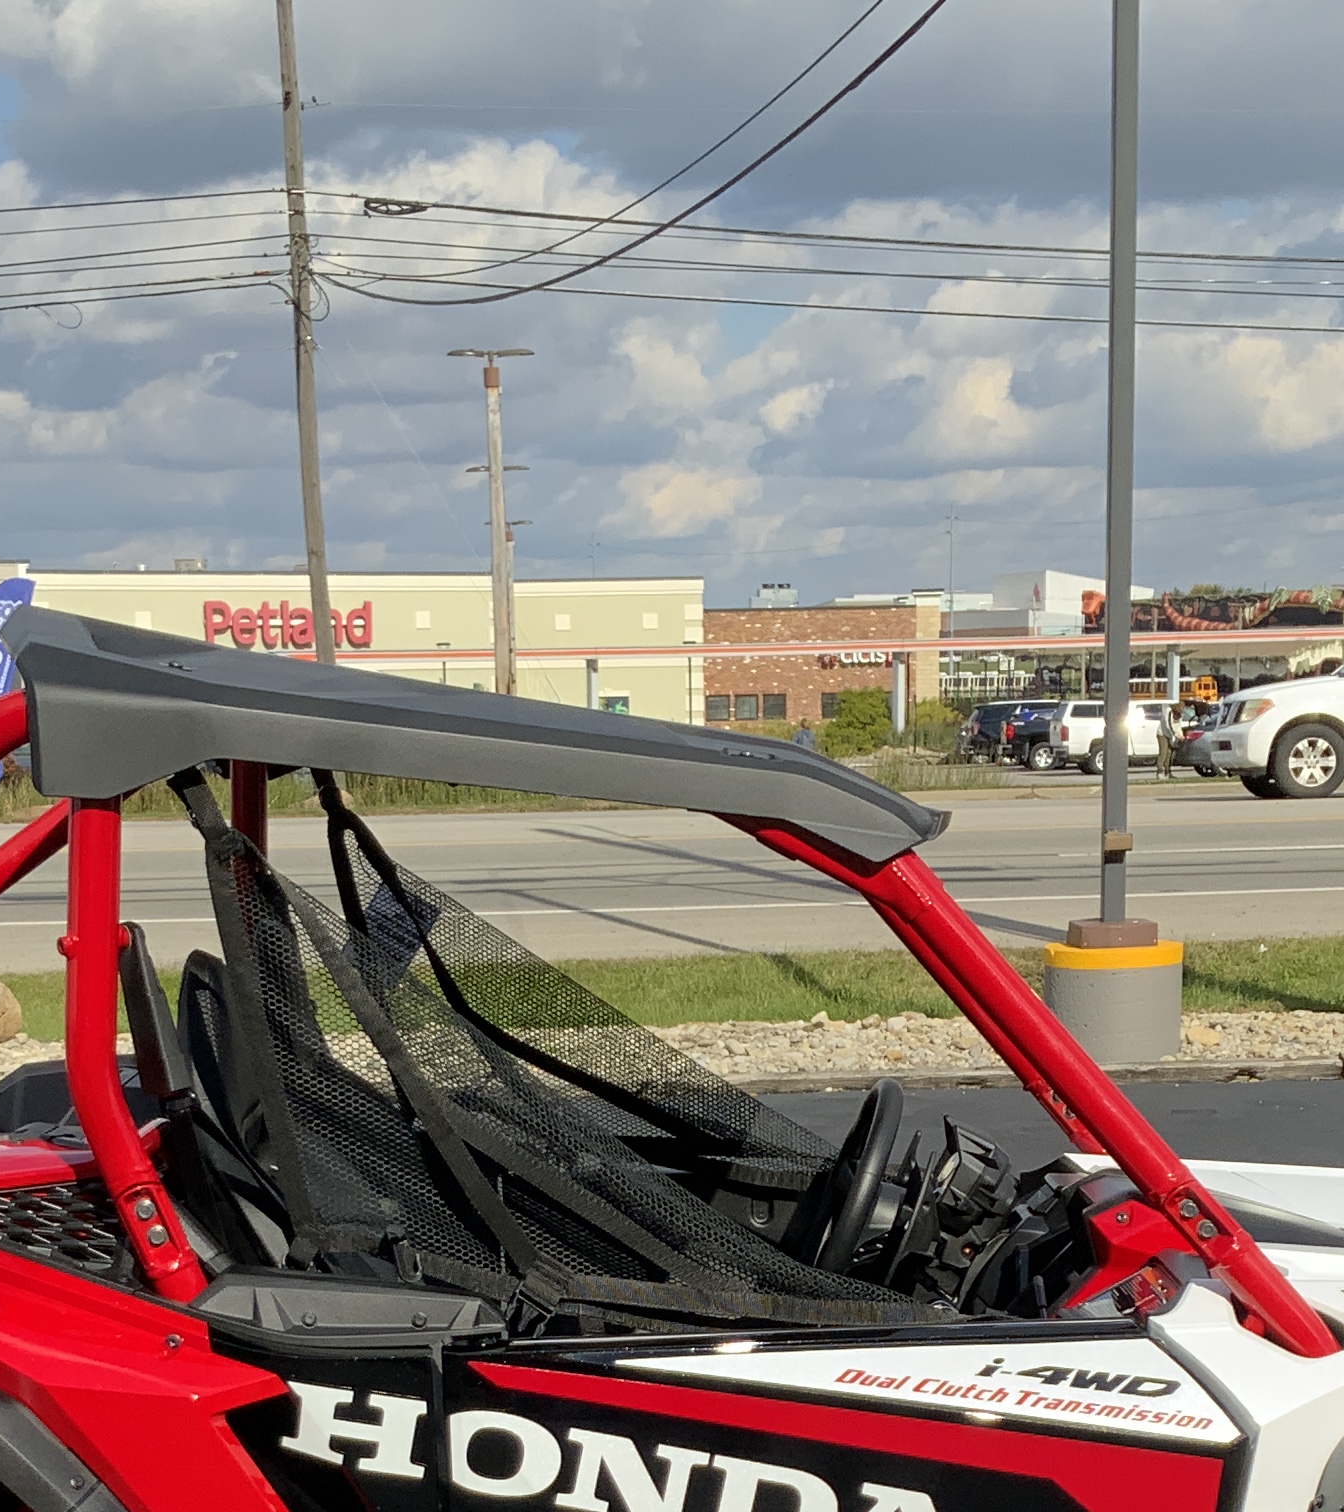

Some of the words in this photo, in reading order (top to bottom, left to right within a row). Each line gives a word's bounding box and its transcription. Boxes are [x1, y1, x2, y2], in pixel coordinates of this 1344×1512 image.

[834, 1368, 911, 1390] Dual
[912, 1377, 1010, 1404] Clutch
[1013, 1389, 1214, 1430] Transmission
[974, 1357, 1182, 1398] i-4WD
